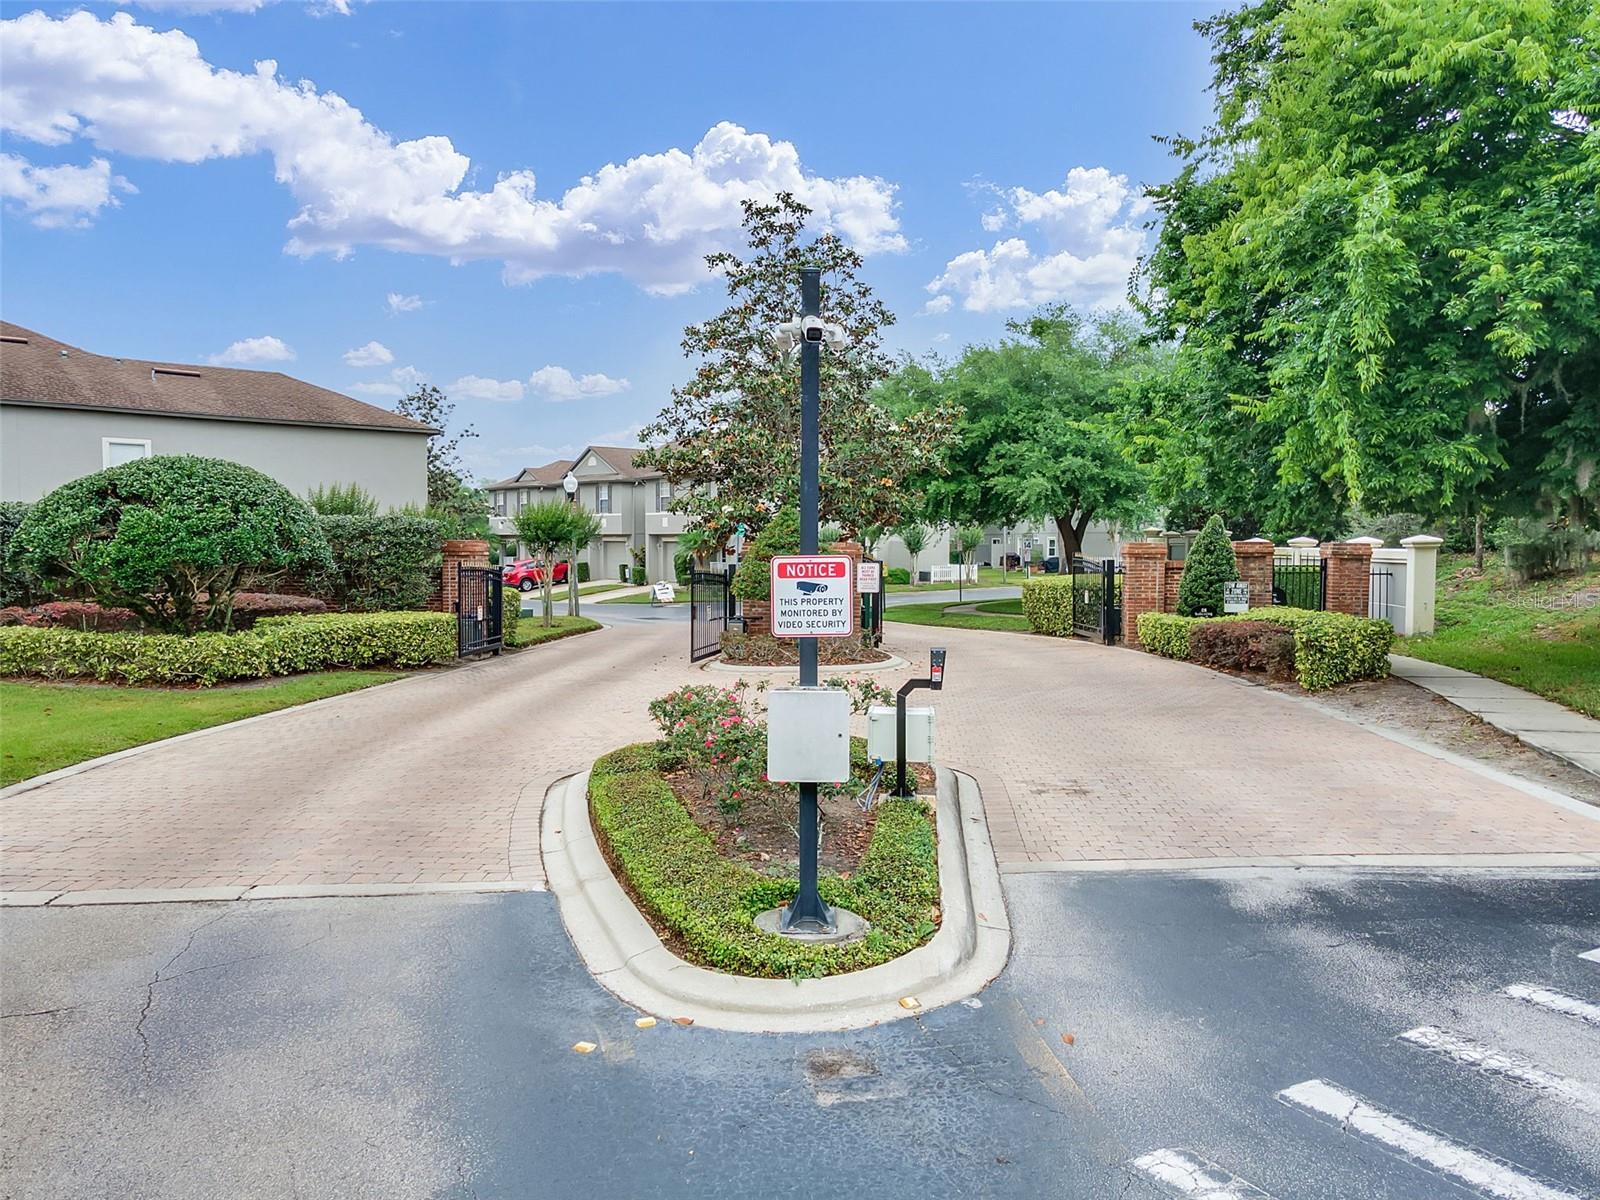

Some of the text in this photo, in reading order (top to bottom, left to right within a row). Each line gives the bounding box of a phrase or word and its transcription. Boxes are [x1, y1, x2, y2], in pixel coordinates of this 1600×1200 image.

[786, 564, 837, 576] NOTICE
[779, 598, 844, 606] THIS PROPERTY
[780, 609, 843, 617] MONITORED BY
[777, 620, 847, 629] VIDEO SECURITY
